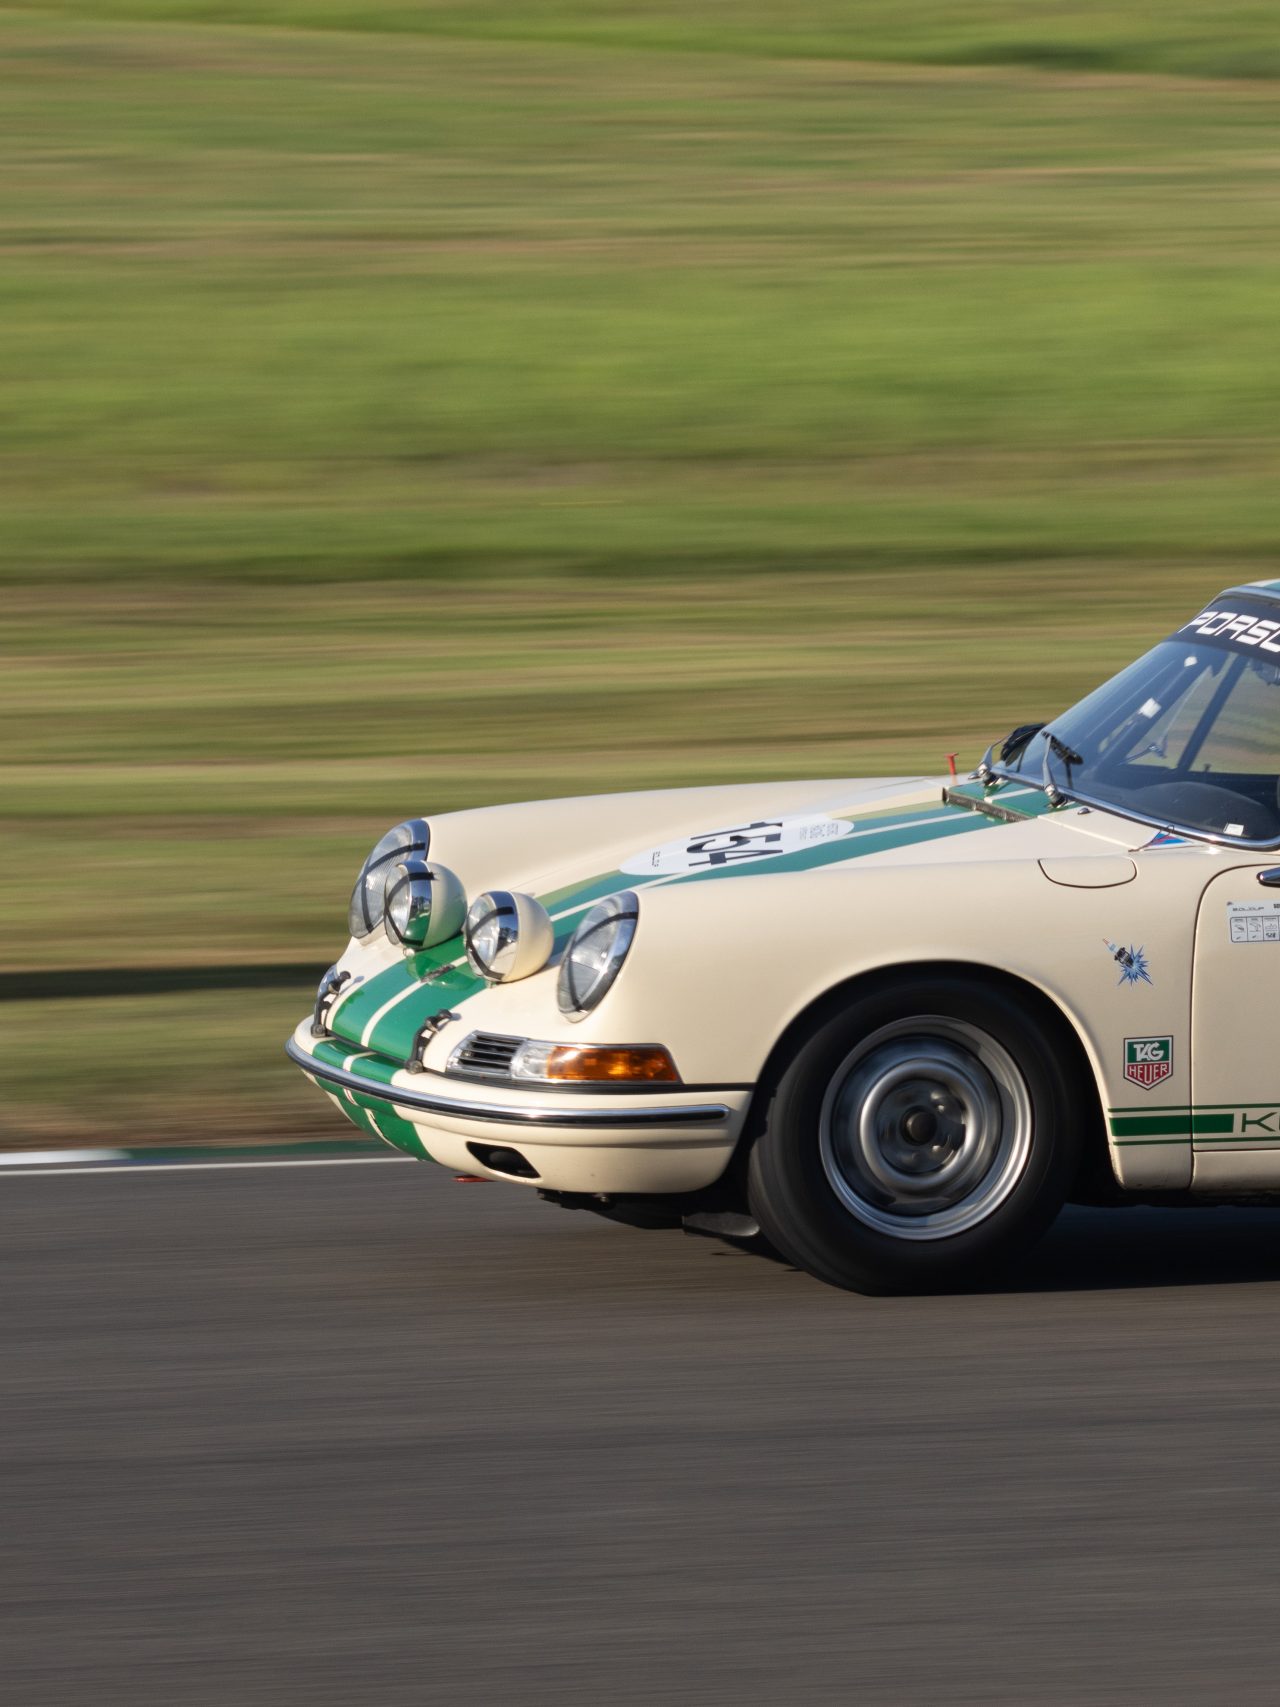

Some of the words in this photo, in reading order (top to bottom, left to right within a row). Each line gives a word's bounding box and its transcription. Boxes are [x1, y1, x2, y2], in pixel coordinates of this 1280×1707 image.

[686, 821, 784, 867] 154
[1133, 1041, 1164, 1062] TAG
[1128, 1063, 1168, 1084] HEUER
